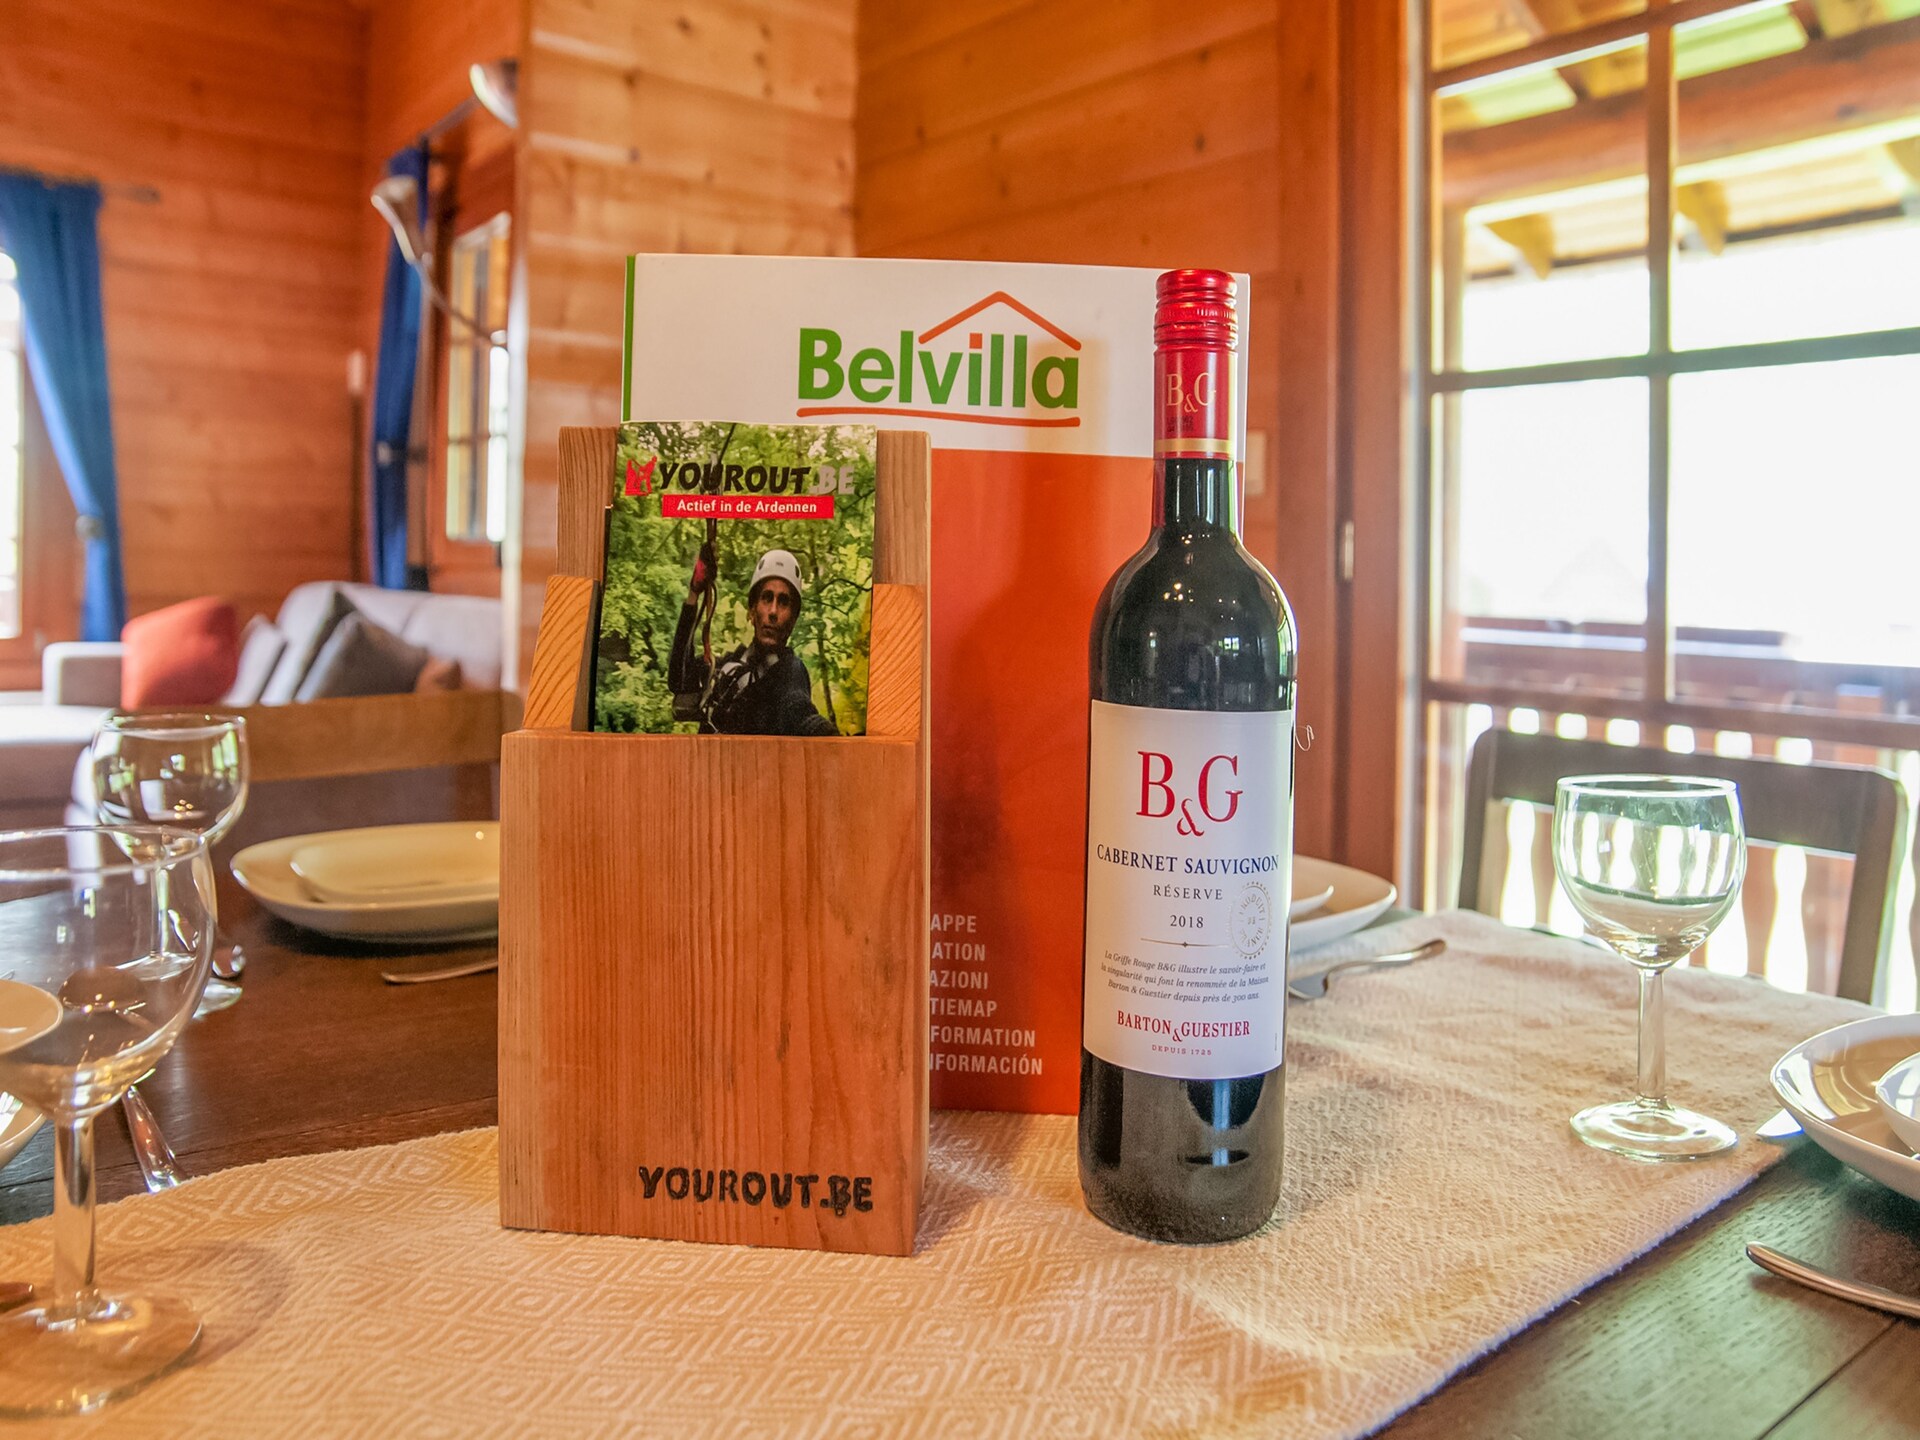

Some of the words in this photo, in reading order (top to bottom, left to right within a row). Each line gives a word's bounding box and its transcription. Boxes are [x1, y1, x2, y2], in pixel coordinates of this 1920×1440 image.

[798, 327, 1080, 409] Belvilla
[677, 499, 716, 513] Actief
[720, 500, 732, 513] in
[736, 501, 751, 513] de
[755, 501, 817, 514] Ardennen
[1136, 751, 1243, 836] B&G
[1097, 843, 1178, 872] CABERNET
[1184, 854, 1280, 875] SAUVIGNON
[1153, 883, 1223, 900] RÉSERVE
[930, 913, 977, 933] APPE
[1170, 914, 1204, 929] 2018
[932, 942, 986, 961] ATION
[1104, 950, 1112, 960] La
[1133, 958, 1156, 970] Rouge
[1157, 962, 1176, 973] B&G
[1178, 964, 1207, 974] illustre
[1209, 965, 1217, 974] le
[930, 970, 989, 990] AZIONI
[1144, 975, 1156, 984] qui
[1157, 976, 1174, 986] font
[1176, 978, 1184, 987] la
[1186, 980, 1227, 988] renommée
[1228, 979, 1238, 988] de
[1239, 978, 1246, 987] la
[1108, 978, 1129, 992] Barton
[1131, 986, 1137, 994] &
[1139, 987, 1171, 1000] Guestier
[1173, 992, 1201, 1003] depuis
[1202, 993, 1220, 1004] près
[1221, 993, 1231, 1002] de
[1231, 994, 1246, 1004] 300
[930, 997, 997, 1018] TIEMAP
[930, 1025, 1036, 1047] FORMATION
[1152, 1044, 1186, 1055] DEPUIS
